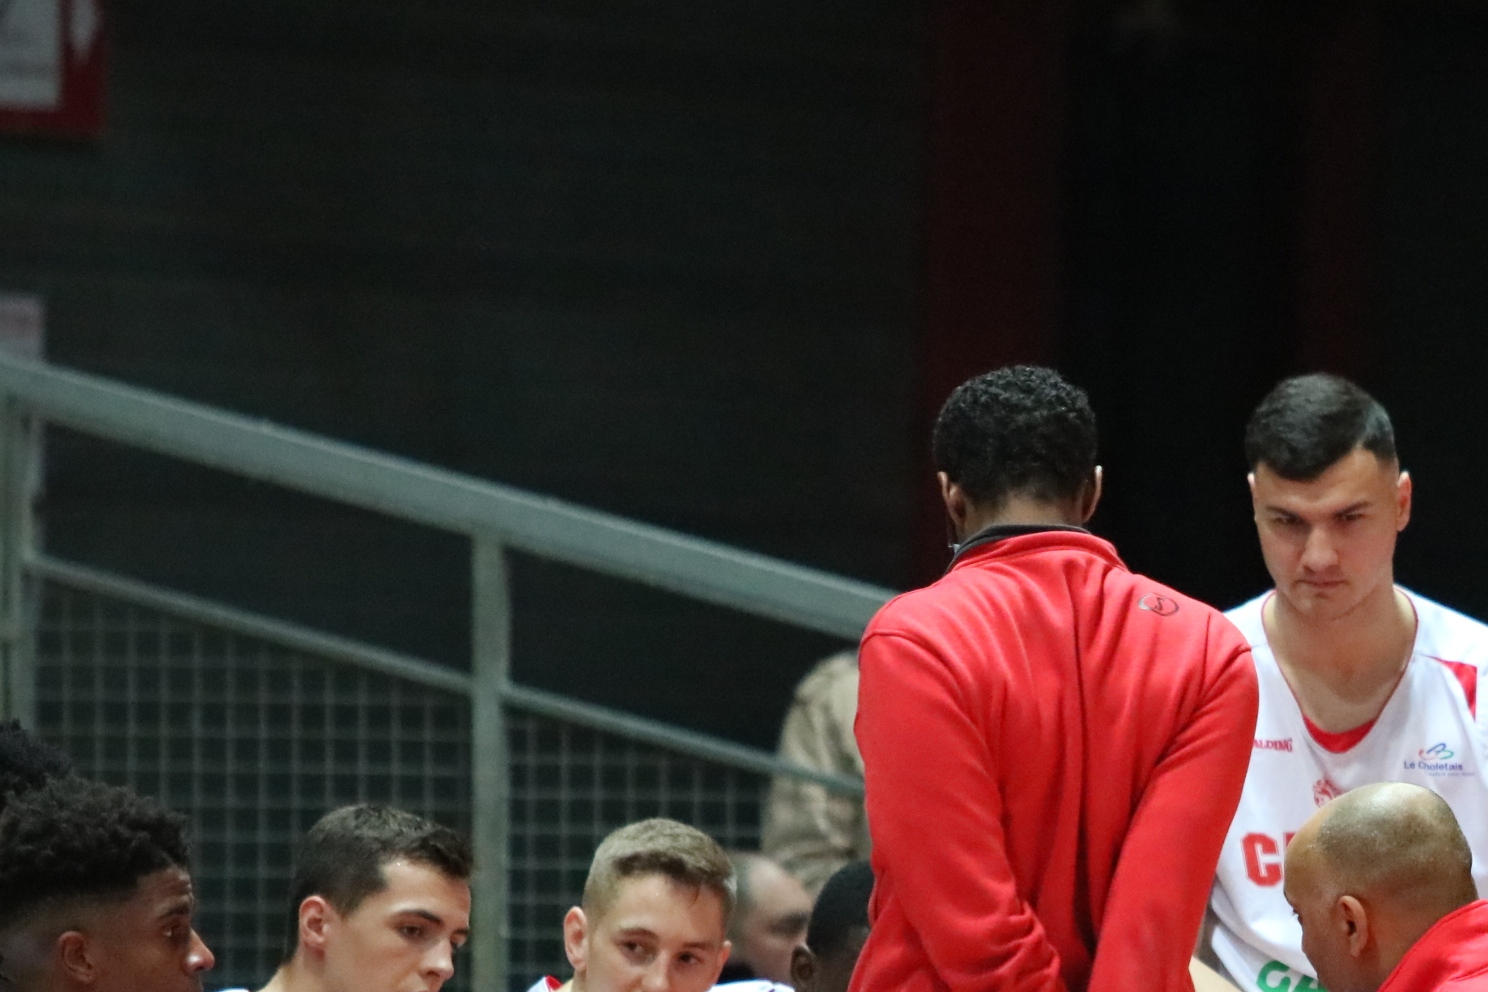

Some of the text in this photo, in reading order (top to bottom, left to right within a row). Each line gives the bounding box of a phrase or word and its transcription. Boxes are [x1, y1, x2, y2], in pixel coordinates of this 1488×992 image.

[1254, 738, 1293, 753] ALDING
[1403, 760, 1463, 772] Le Choletais
